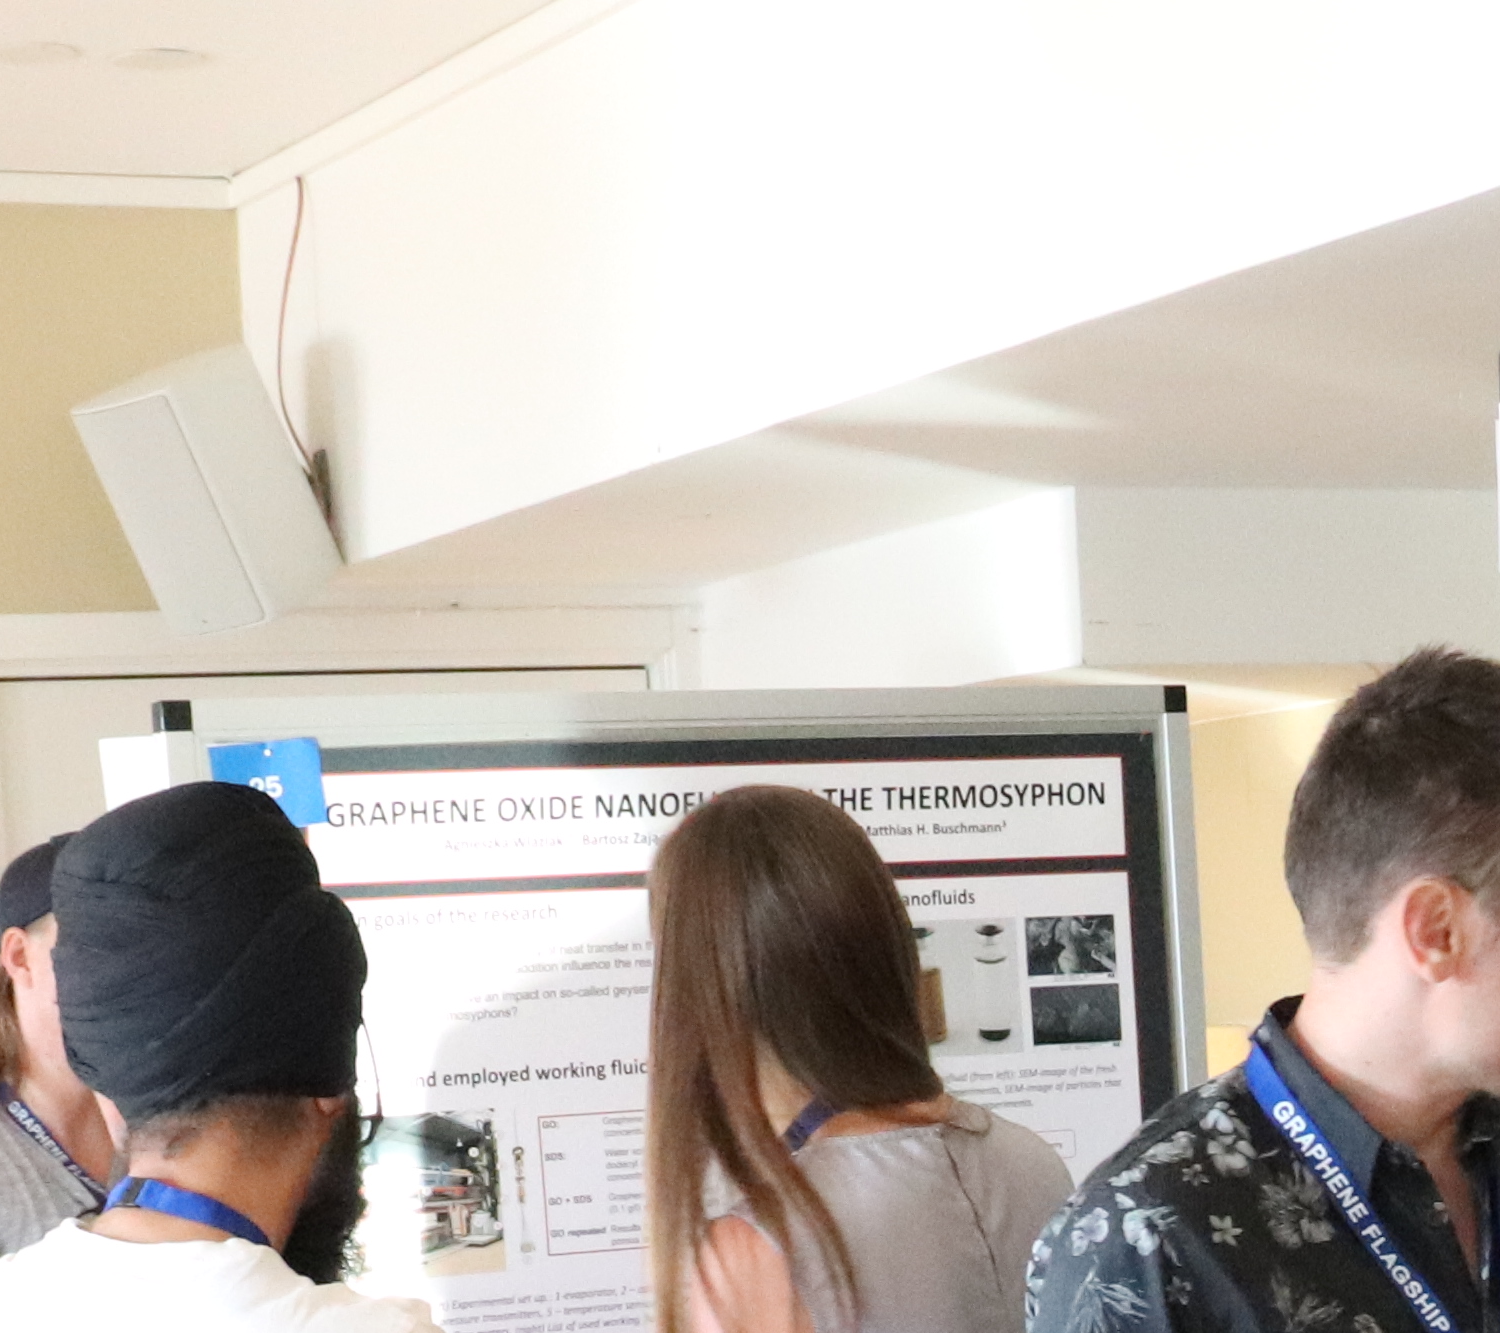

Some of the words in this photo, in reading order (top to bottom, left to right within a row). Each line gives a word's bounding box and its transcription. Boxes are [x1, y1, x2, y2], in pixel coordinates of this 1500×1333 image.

[326, 798, 486, 829] GRAPHENE
[498, 795, 584, 822] OXIDE
[822, 787, 873, 811] THE
[882, 782, 1106, 811] THERMOSYPHON
[901, 889, 976, 907] anofluids
[374, 910, 419, 931] goals
[425, 909, 443, 925] of
[450, 909, 477, 924] the
[484, 904, 558, 923] research
[442, 1065, 531, 1088] employed
[535, 1062, 606, 1081] working
[1272, 1100, 1369, 1224] GRAPHENE
[1361, 1223, 1450, 1333] FLAGSHIP
